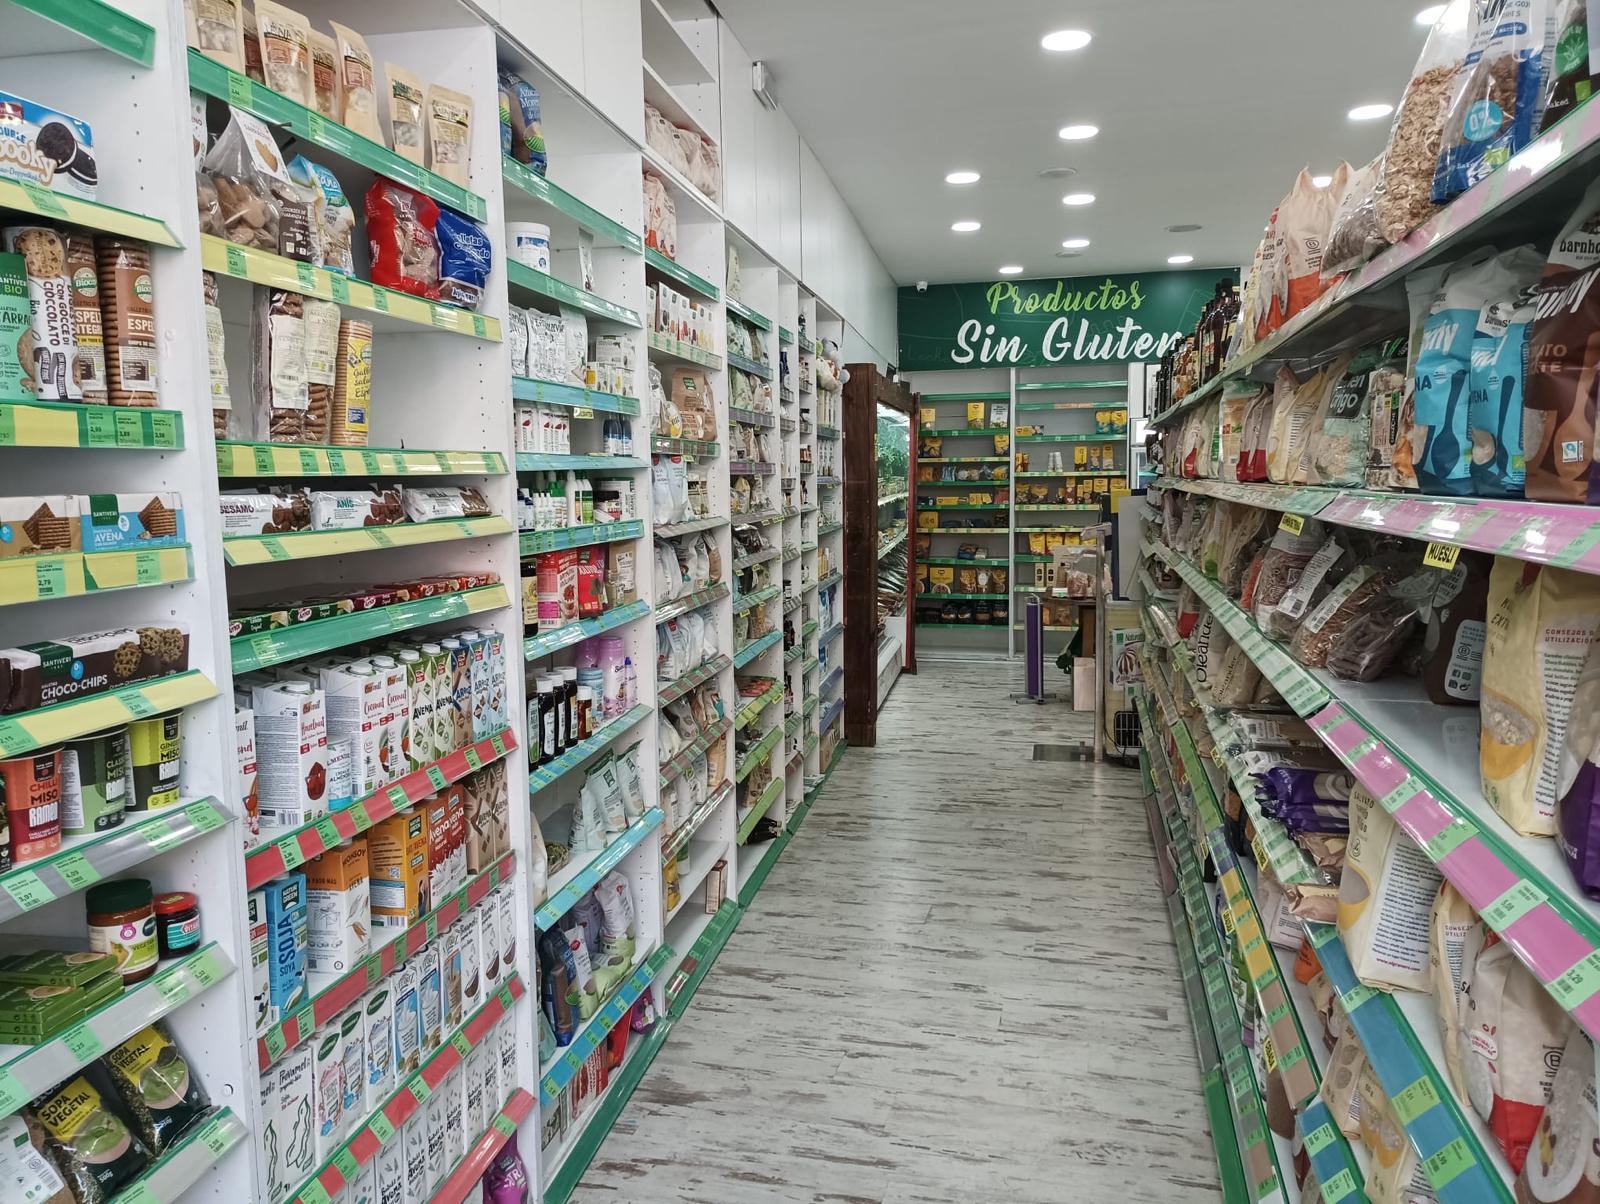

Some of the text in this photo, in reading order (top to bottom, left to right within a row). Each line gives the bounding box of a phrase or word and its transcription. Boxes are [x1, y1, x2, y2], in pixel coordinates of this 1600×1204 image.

[0, 139, 57, 186] ooky
[1559, 239, 1600, 254] barnho
[5, 285, 22, 295] BIO
[987, 279, 1146, 314] Productos
[43, 280, 61, 346] CIOCCOLATO
[59, 301, 70, 334] GOCCE
[62, 334, 70, 346] DI
[951, 319, 1028, 364] Sin
[94, 530, 124, 543] AVENA
[1428, 543, 1457, 563] MUESLI
[1545, 628, 1586, 637] CONSEJOS
[1195, 611, 1214, 683] Oleande
[43, 656, 72, 668] SANTIVERI
[41, 674, 108, 701] CHOCO-CHIPS
[412, 703, 433, 720] AVENA
[435, 695, 454, 711] AVENA
[31, 789, 58, 806] MISO
[449, 806, 465, 825] vena
[342, 848, 367, 865] MONSOY
[282, 883, 298, 896] NATUR
[282, 892, 299, 905] GREEN
[277, 913, 296, 965] SOJA
[279, 963, 296, 977] SOYA
[1566, 969, 1584, 985] 3,29
[111, 1046, 131, 1063] SOPA
[118, 1043, 150, 1069] VEGETAL
[41, 1092, 71, 1121] SOPA
[50, 1092, 91, 1128] VEGETAL
